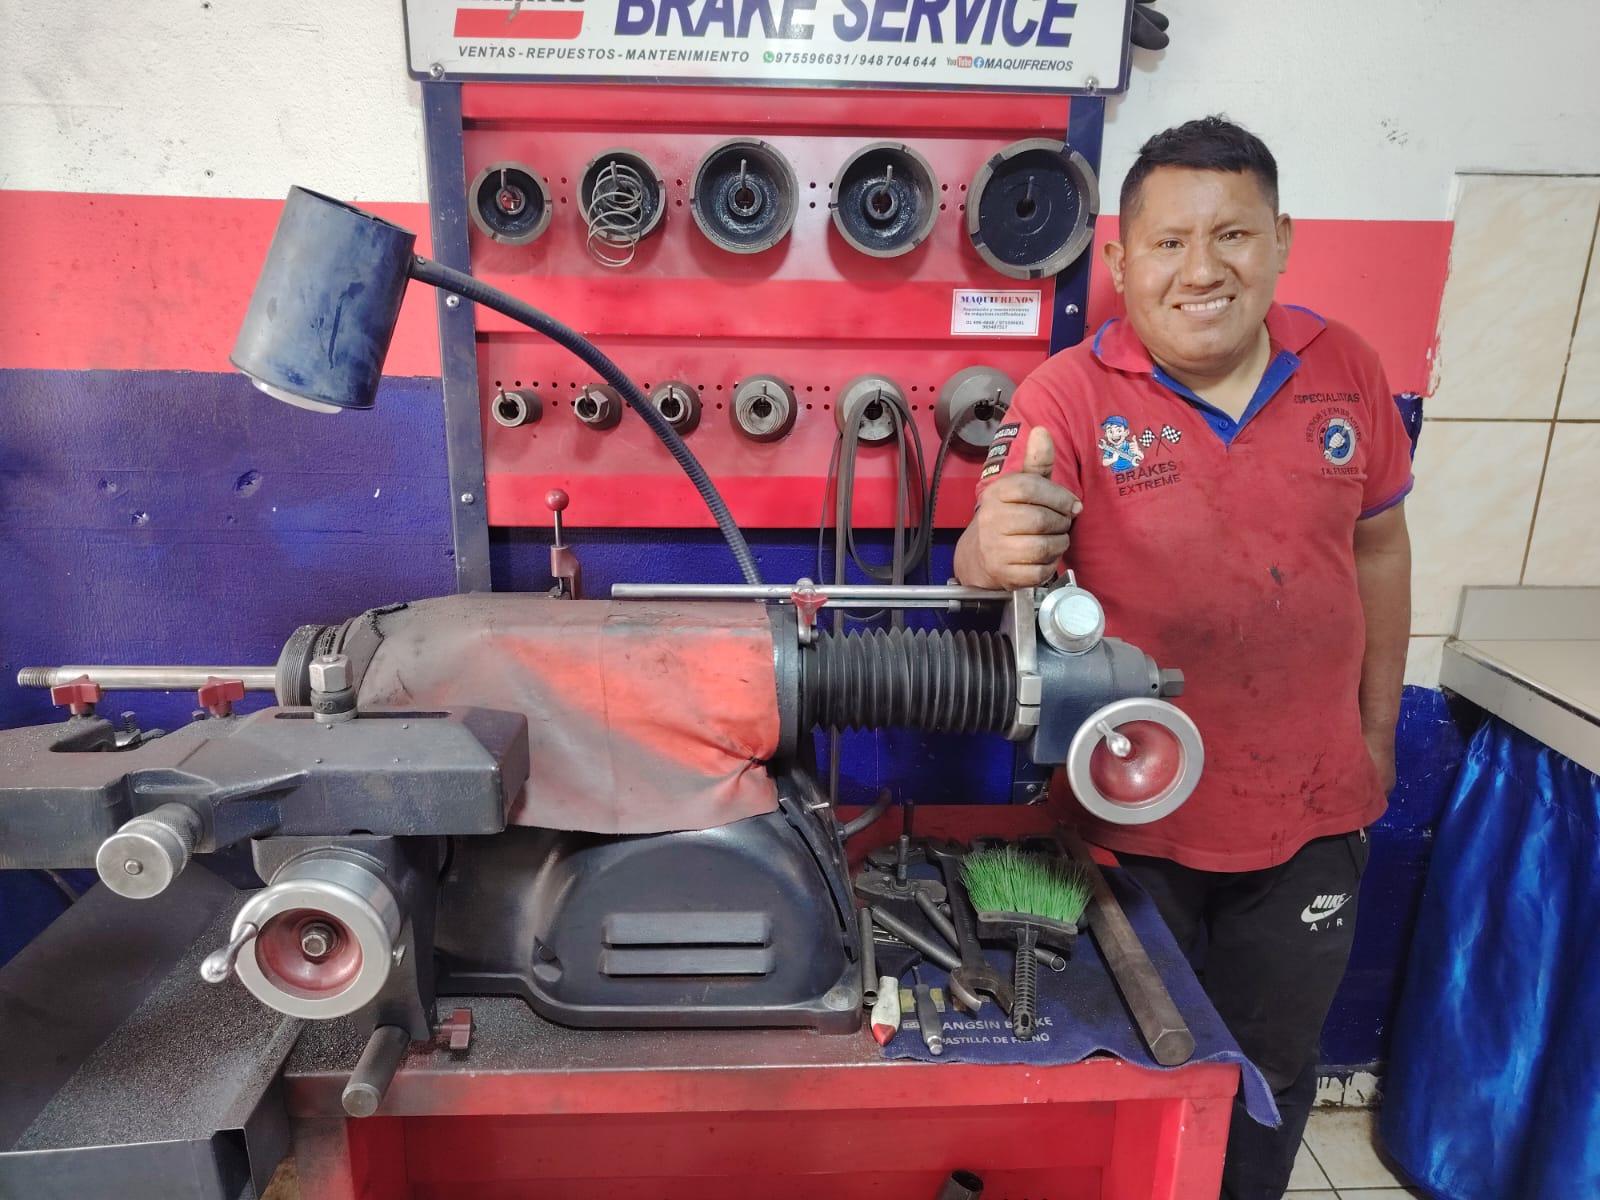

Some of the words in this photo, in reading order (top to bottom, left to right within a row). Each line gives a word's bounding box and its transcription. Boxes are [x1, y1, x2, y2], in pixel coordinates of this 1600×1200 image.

[614, 0, 817, 40] BRAKE
[832, 0, 1078, 49] SERVICE
[984, 58, 1074, 71] MAQUIFRENOS
[1115, 460, 1177, 485] BRAKES
[1119, 473, 1182, 496] EXTREME
[1311, 893, 1347, 909] NIKE
[942, 1020, 1000, 1031] ANGSIN
[1004, 1016, 1053, 1030] BKE
[941, 1035, 990, 1045] ASTILLA
[993, 1036, 1009, 1044] DE
[1011, 1032, 1050, 1044] FNO
